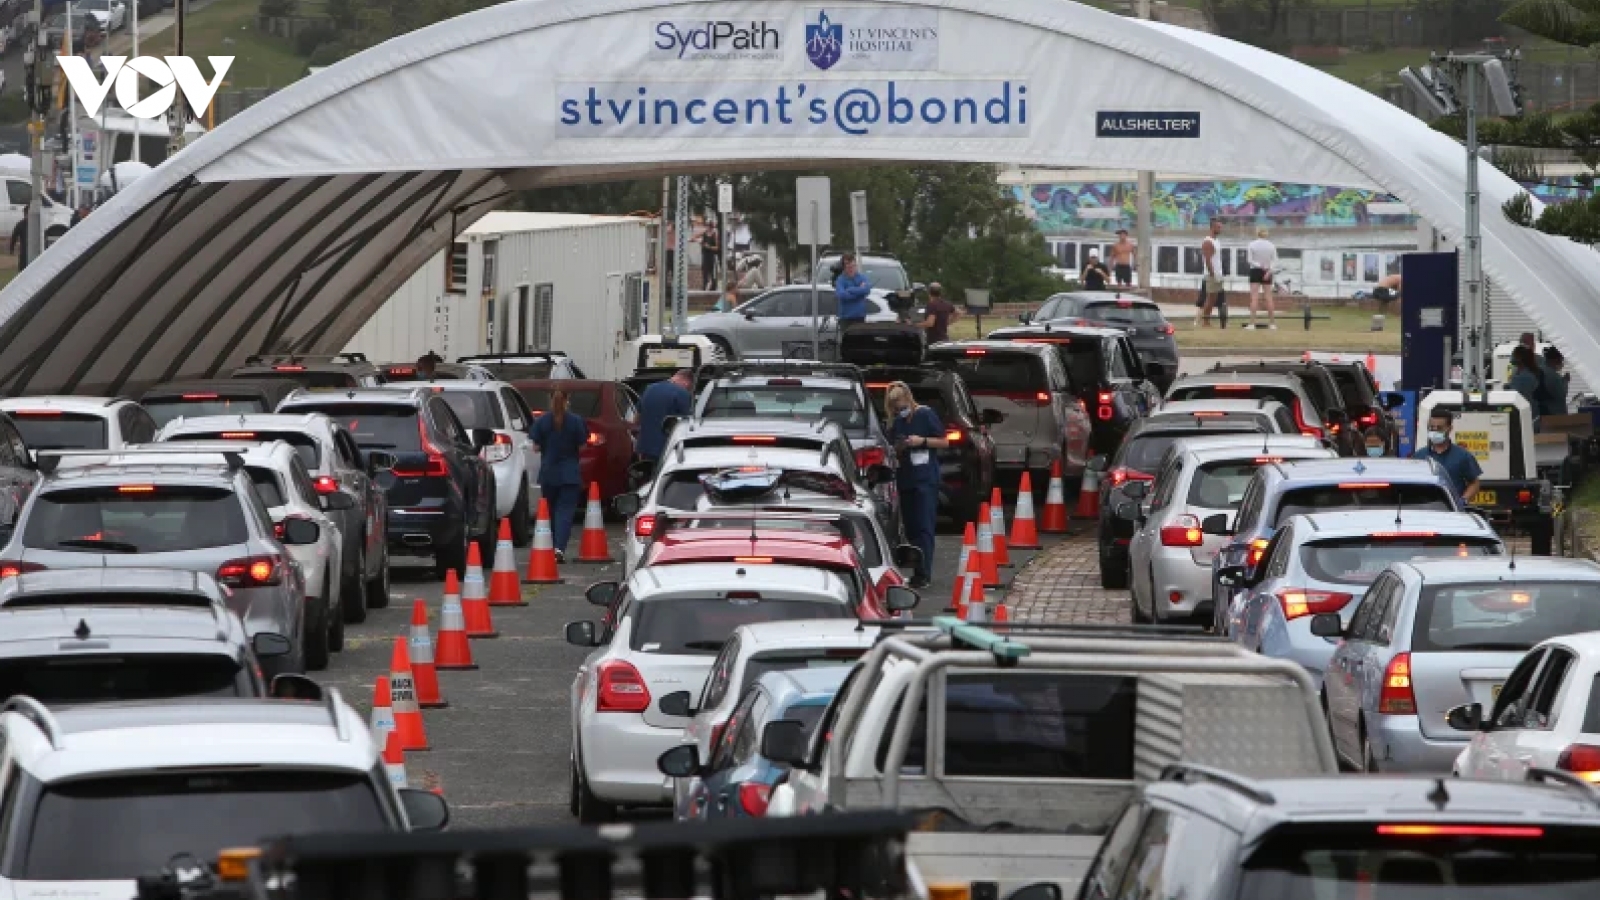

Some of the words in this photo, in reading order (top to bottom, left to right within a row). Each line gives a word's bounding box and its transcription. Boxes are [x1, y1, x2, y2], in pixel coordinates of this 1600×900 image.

[655, 20, 779, 60] SydPath
[849, 40, 913, 52] HOSPITAL
[560, 80, 1028, 135] stvincent's@bondi
